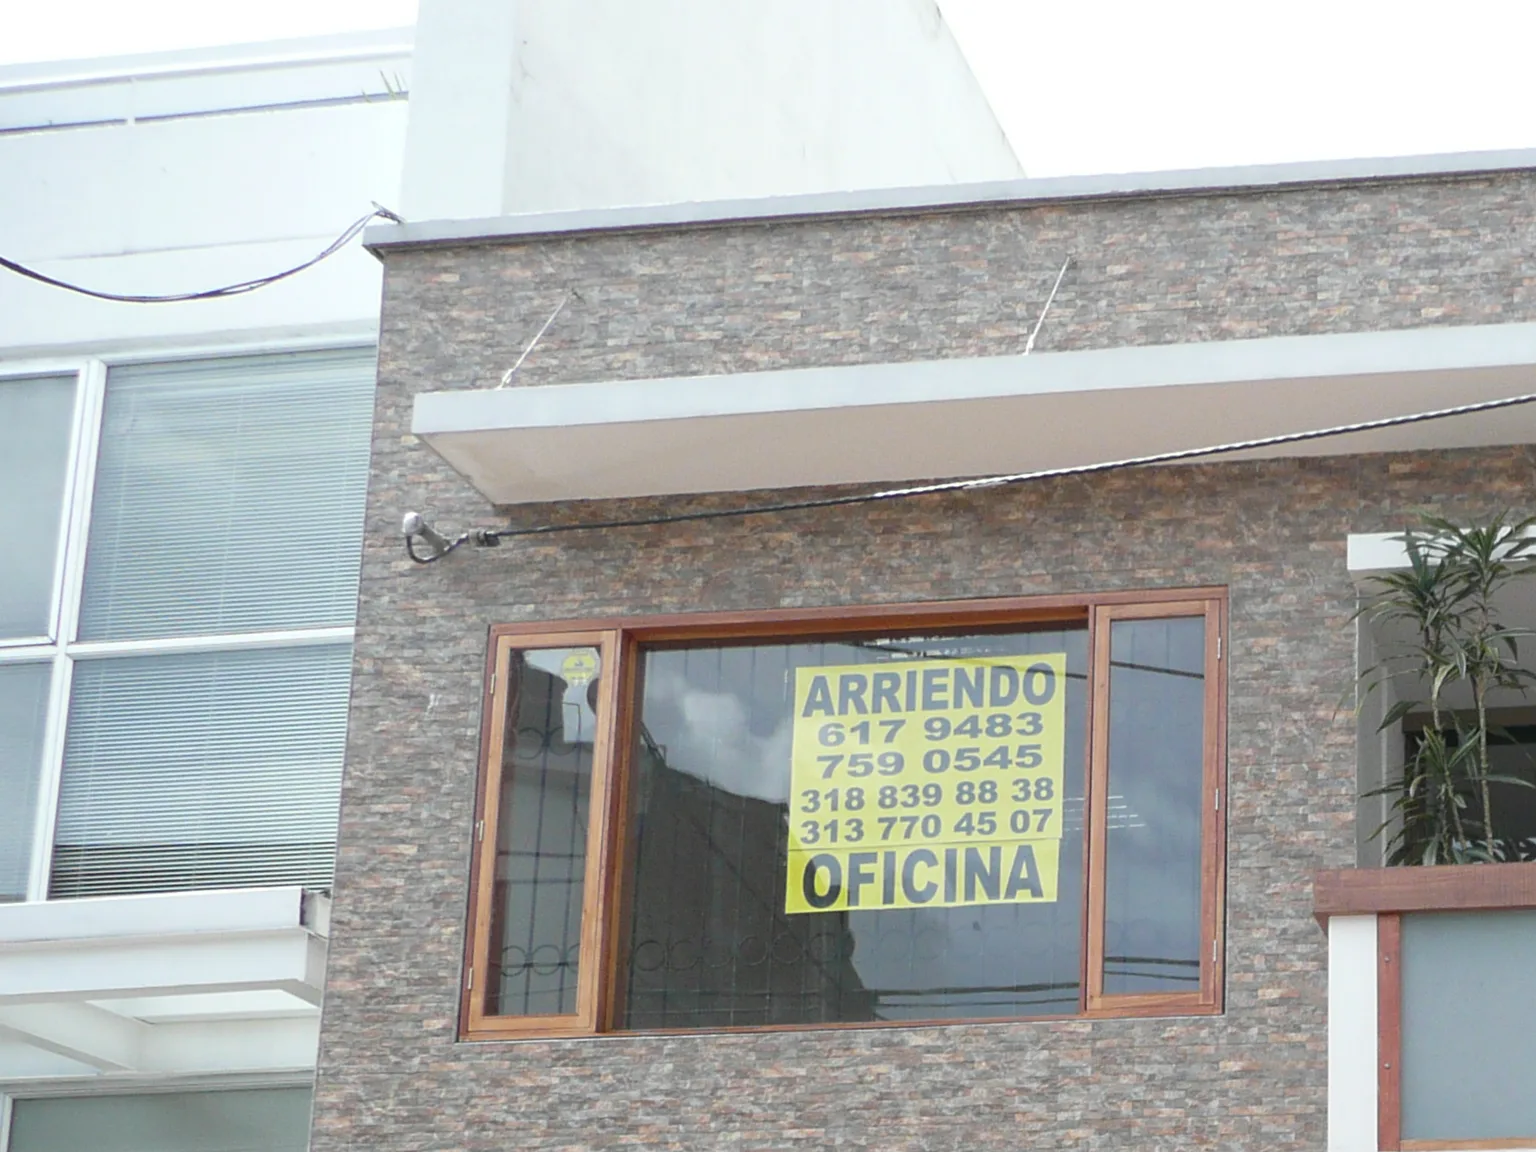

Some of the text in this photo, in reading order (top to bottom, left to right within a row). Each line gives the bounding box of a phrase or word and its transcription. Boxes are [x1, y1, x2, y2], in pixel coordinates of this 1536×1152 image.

[801, 661, 1057, 718] ARRIENDO
[817, 711, 1044, 747] 617 9483
[815, 743, 1043, 779] 759 0545
[800, 776, 1054, 813] 318 839 88 38
[800, 808, 1053, 844] 313 770 45 07
[802, 843, 1045, 909] OFICINA
